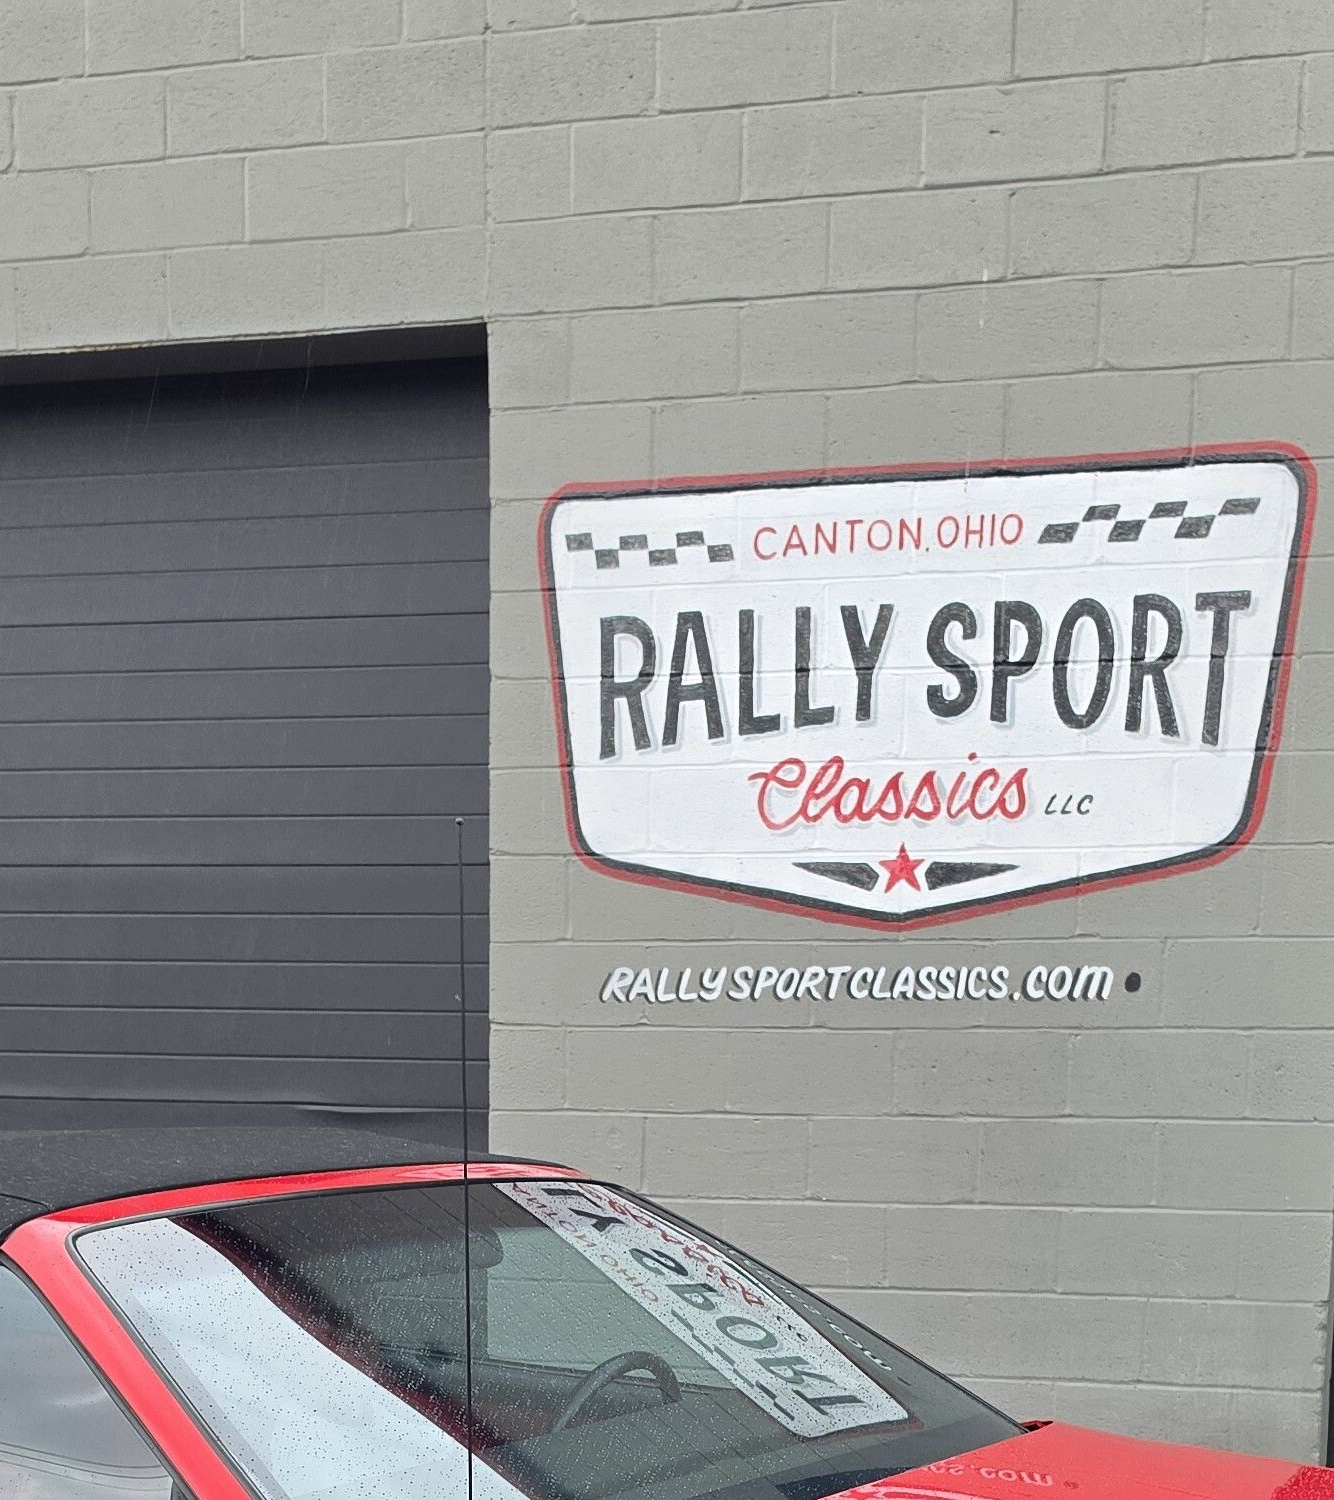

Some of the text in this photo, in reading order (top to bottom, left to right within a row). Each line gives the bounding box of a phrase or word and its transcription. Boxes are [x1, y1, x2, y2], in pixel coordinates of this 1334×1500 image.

[936, 513, 1024, 549] OHIO
[598, 588, 1252, 760] RALLY SPORT
[747, 751, 1029, 831] Classics
[1043, 793, 1094, 816] LLC
